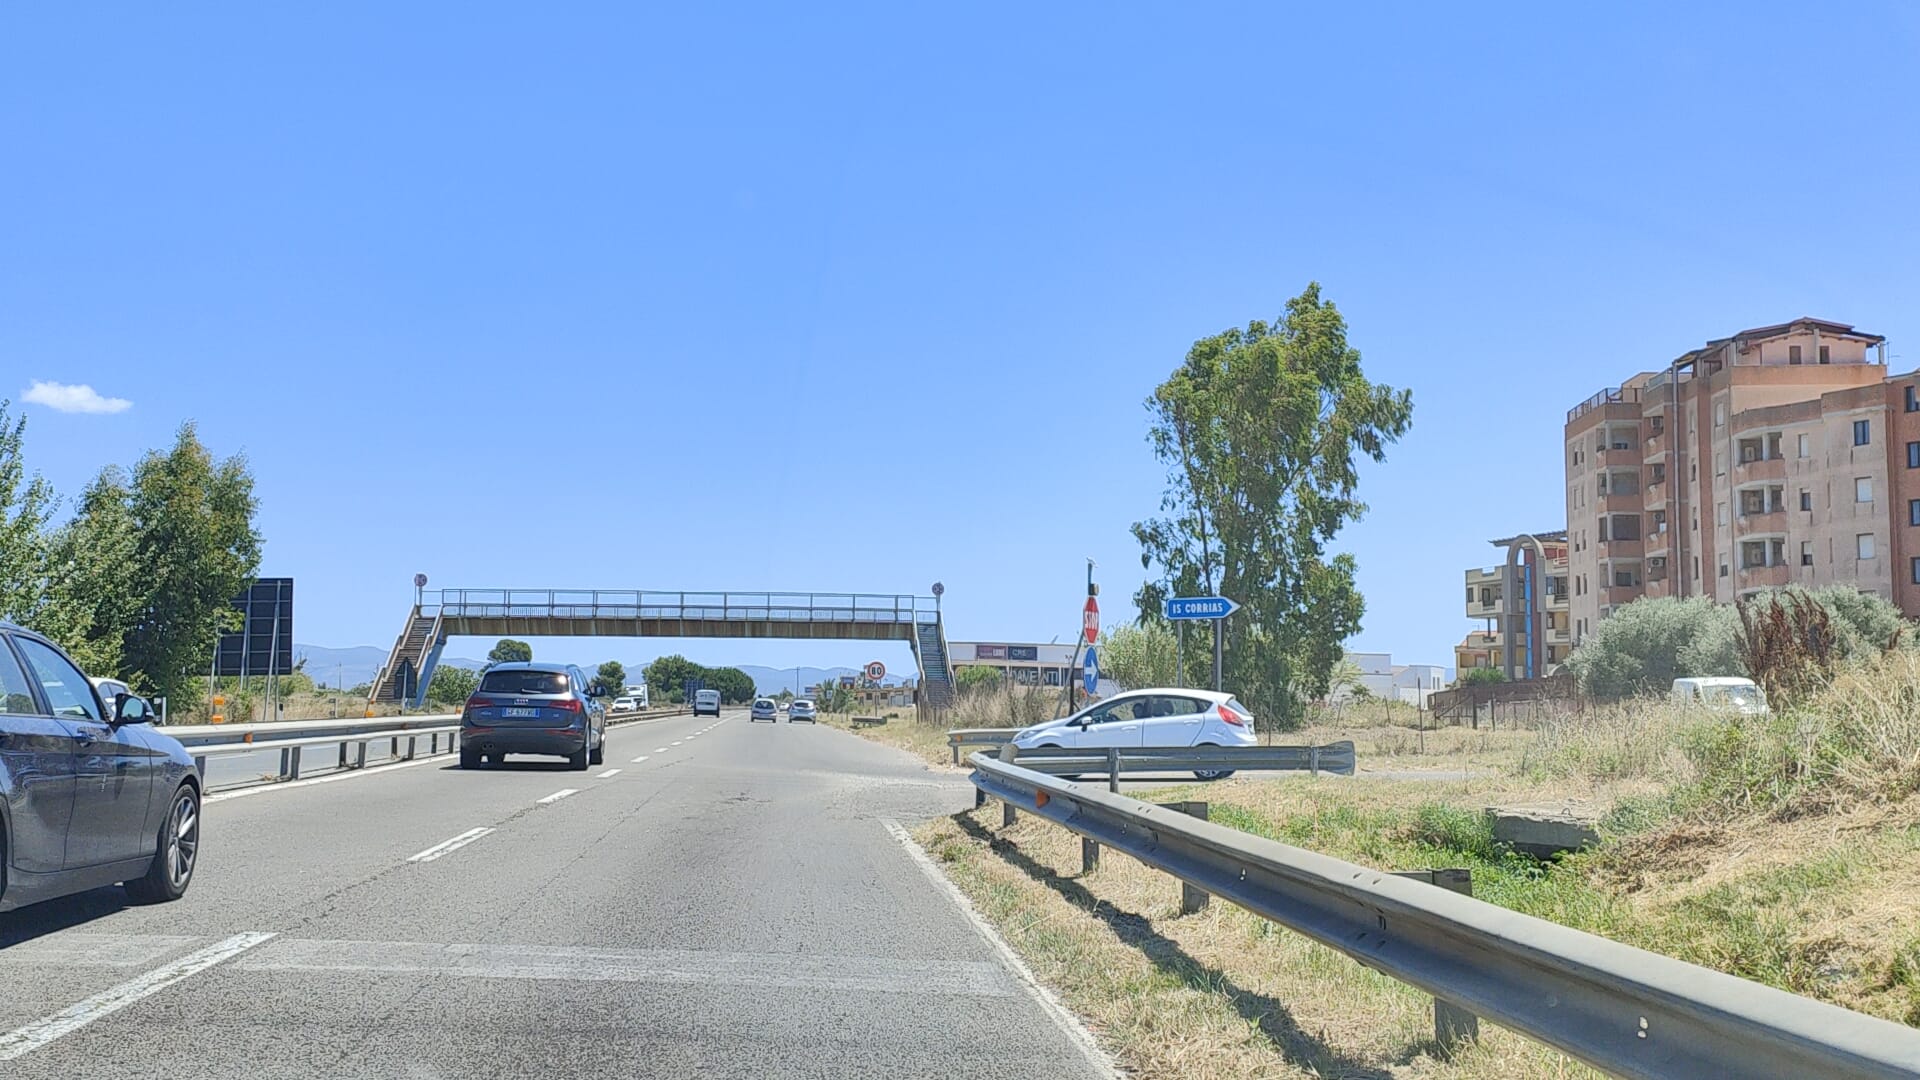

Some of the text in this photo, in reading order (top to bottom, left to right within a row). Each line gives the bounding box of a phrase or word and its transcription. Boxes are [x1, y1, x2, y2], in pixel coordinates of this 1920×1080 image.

[1173, 602, 1223, 614] IS CORRIAS
[1085, 611, 1098, 630] STOP
